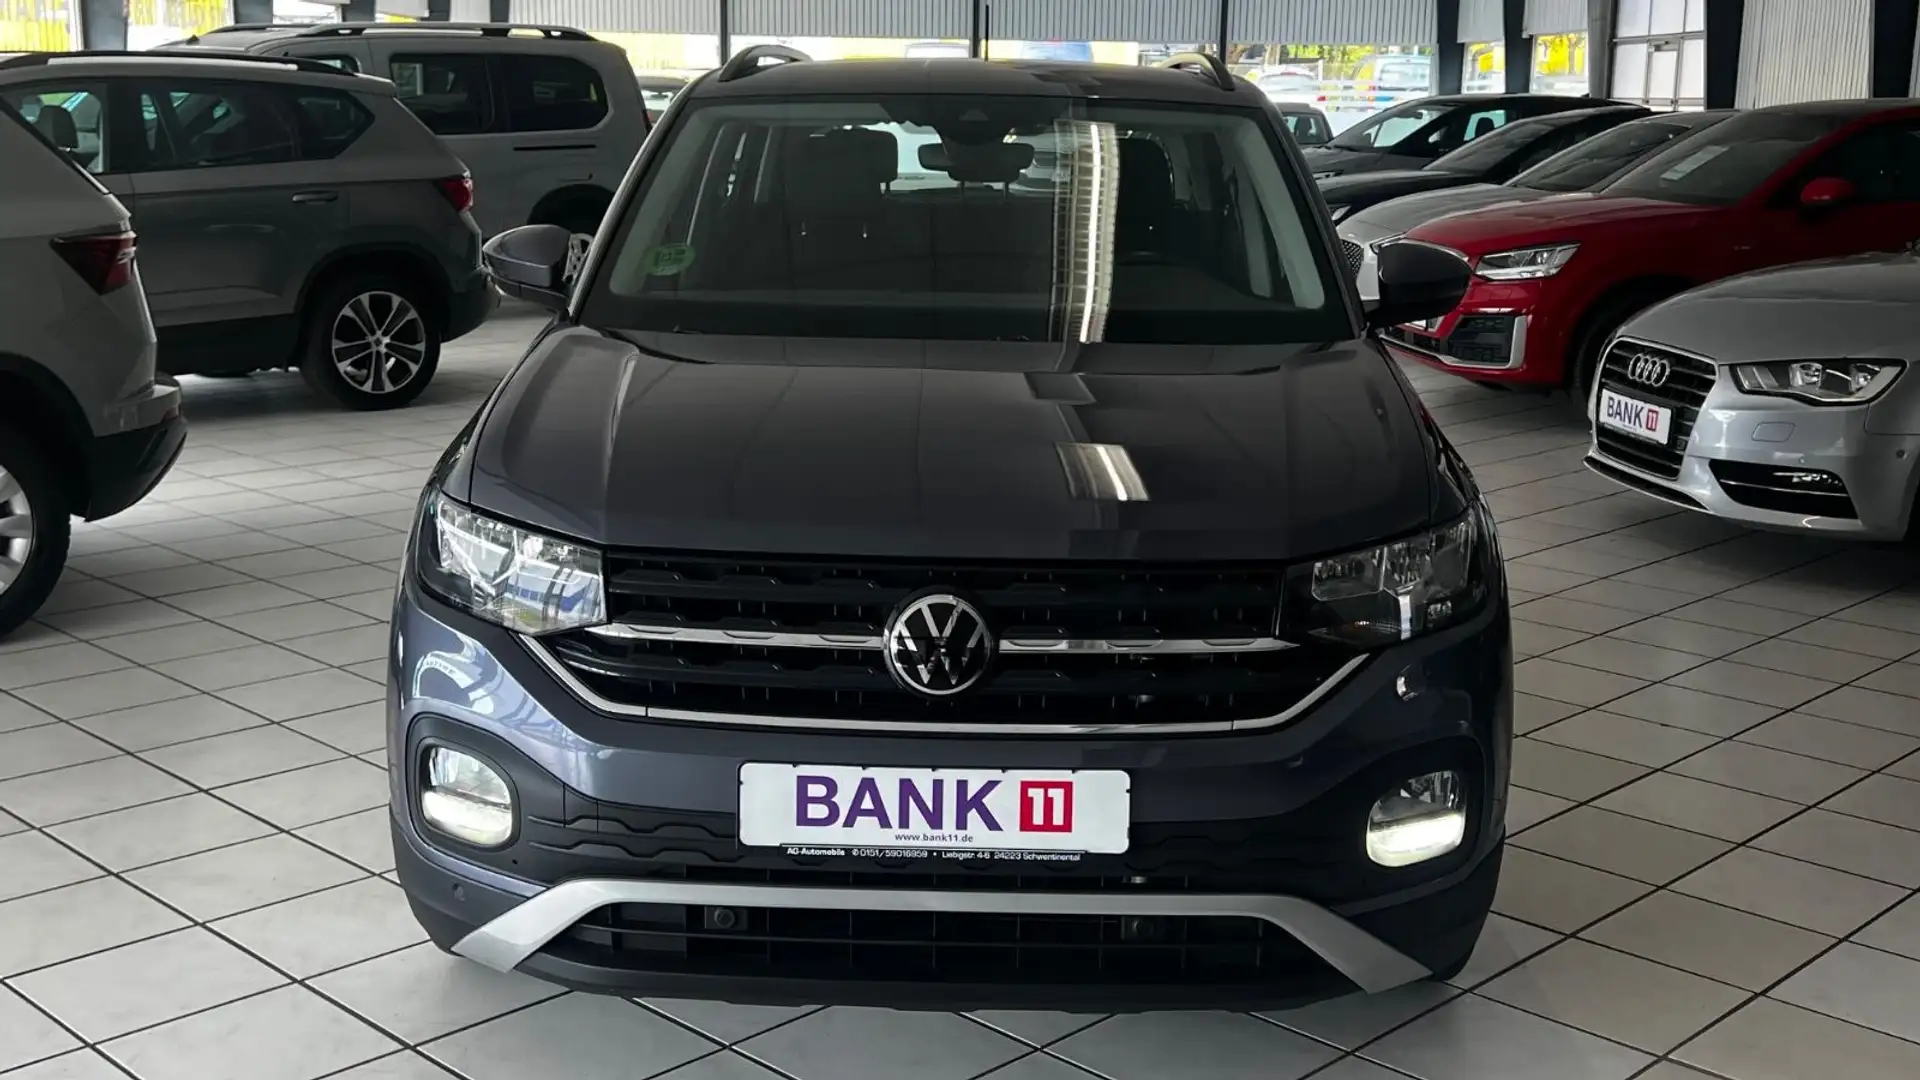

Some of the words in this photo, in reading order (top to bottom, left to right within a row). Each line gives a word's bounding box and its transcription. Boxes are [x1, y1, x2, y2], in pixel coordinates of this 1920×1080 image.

[1607, 396, 1645, 429] BANK
[1647, 410, 1658, 430] 11
[795, 775, 1003, 832] BANK
[1025, 785, 1067, 829] 11
[895, 833, 974, 843] www.bank11.de
[786, 847, 846, 857] AG-Automobile
[1022, 852, 1082, 862] Schwentinental
